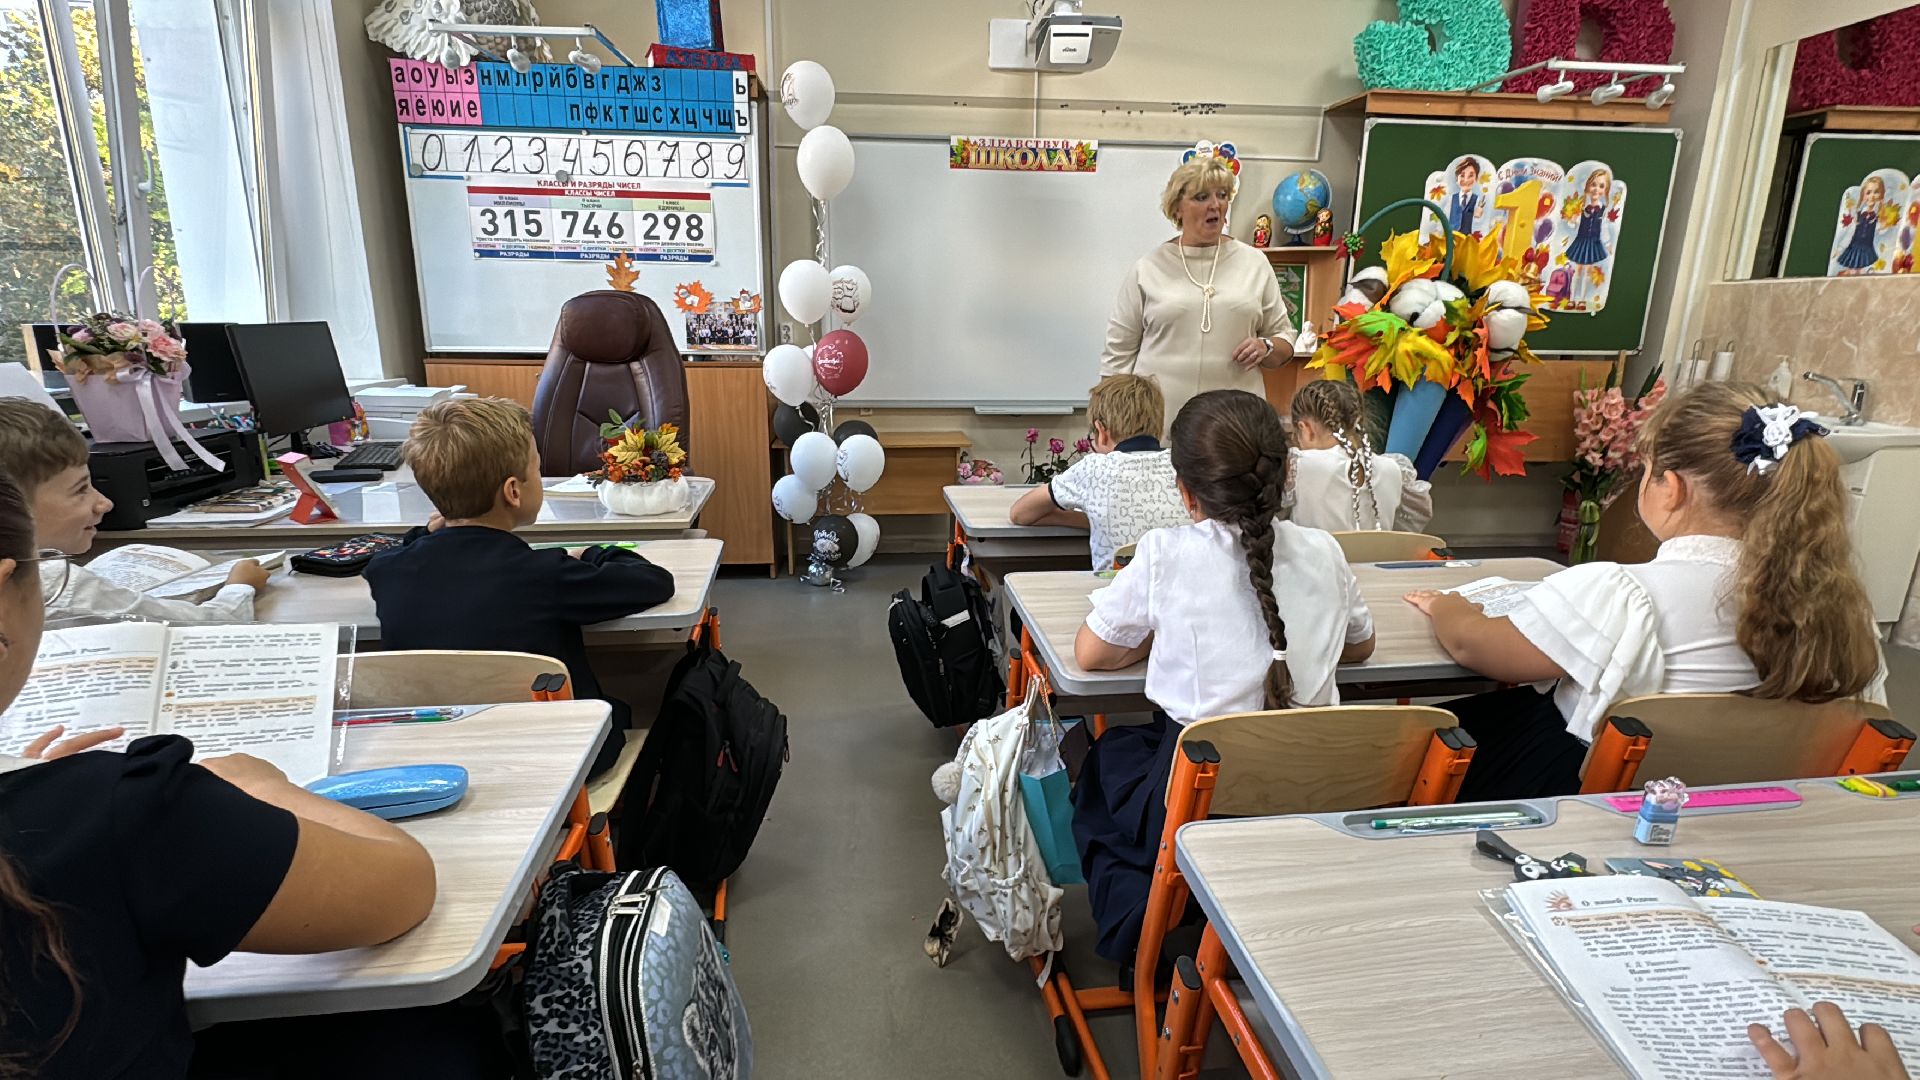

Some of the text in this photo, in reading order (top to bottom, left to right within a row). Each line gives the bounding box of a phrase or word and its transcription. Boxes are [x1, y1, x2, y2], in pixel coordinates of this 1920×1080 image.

[665, 50, 741, 69] АЗБУКА
[968, 148, 1077, 171] ШКОЛА!
[480, 208, 542, 237] 315
[561, 211, 624, 239] 746
[642, 213, 703, 241] 298
